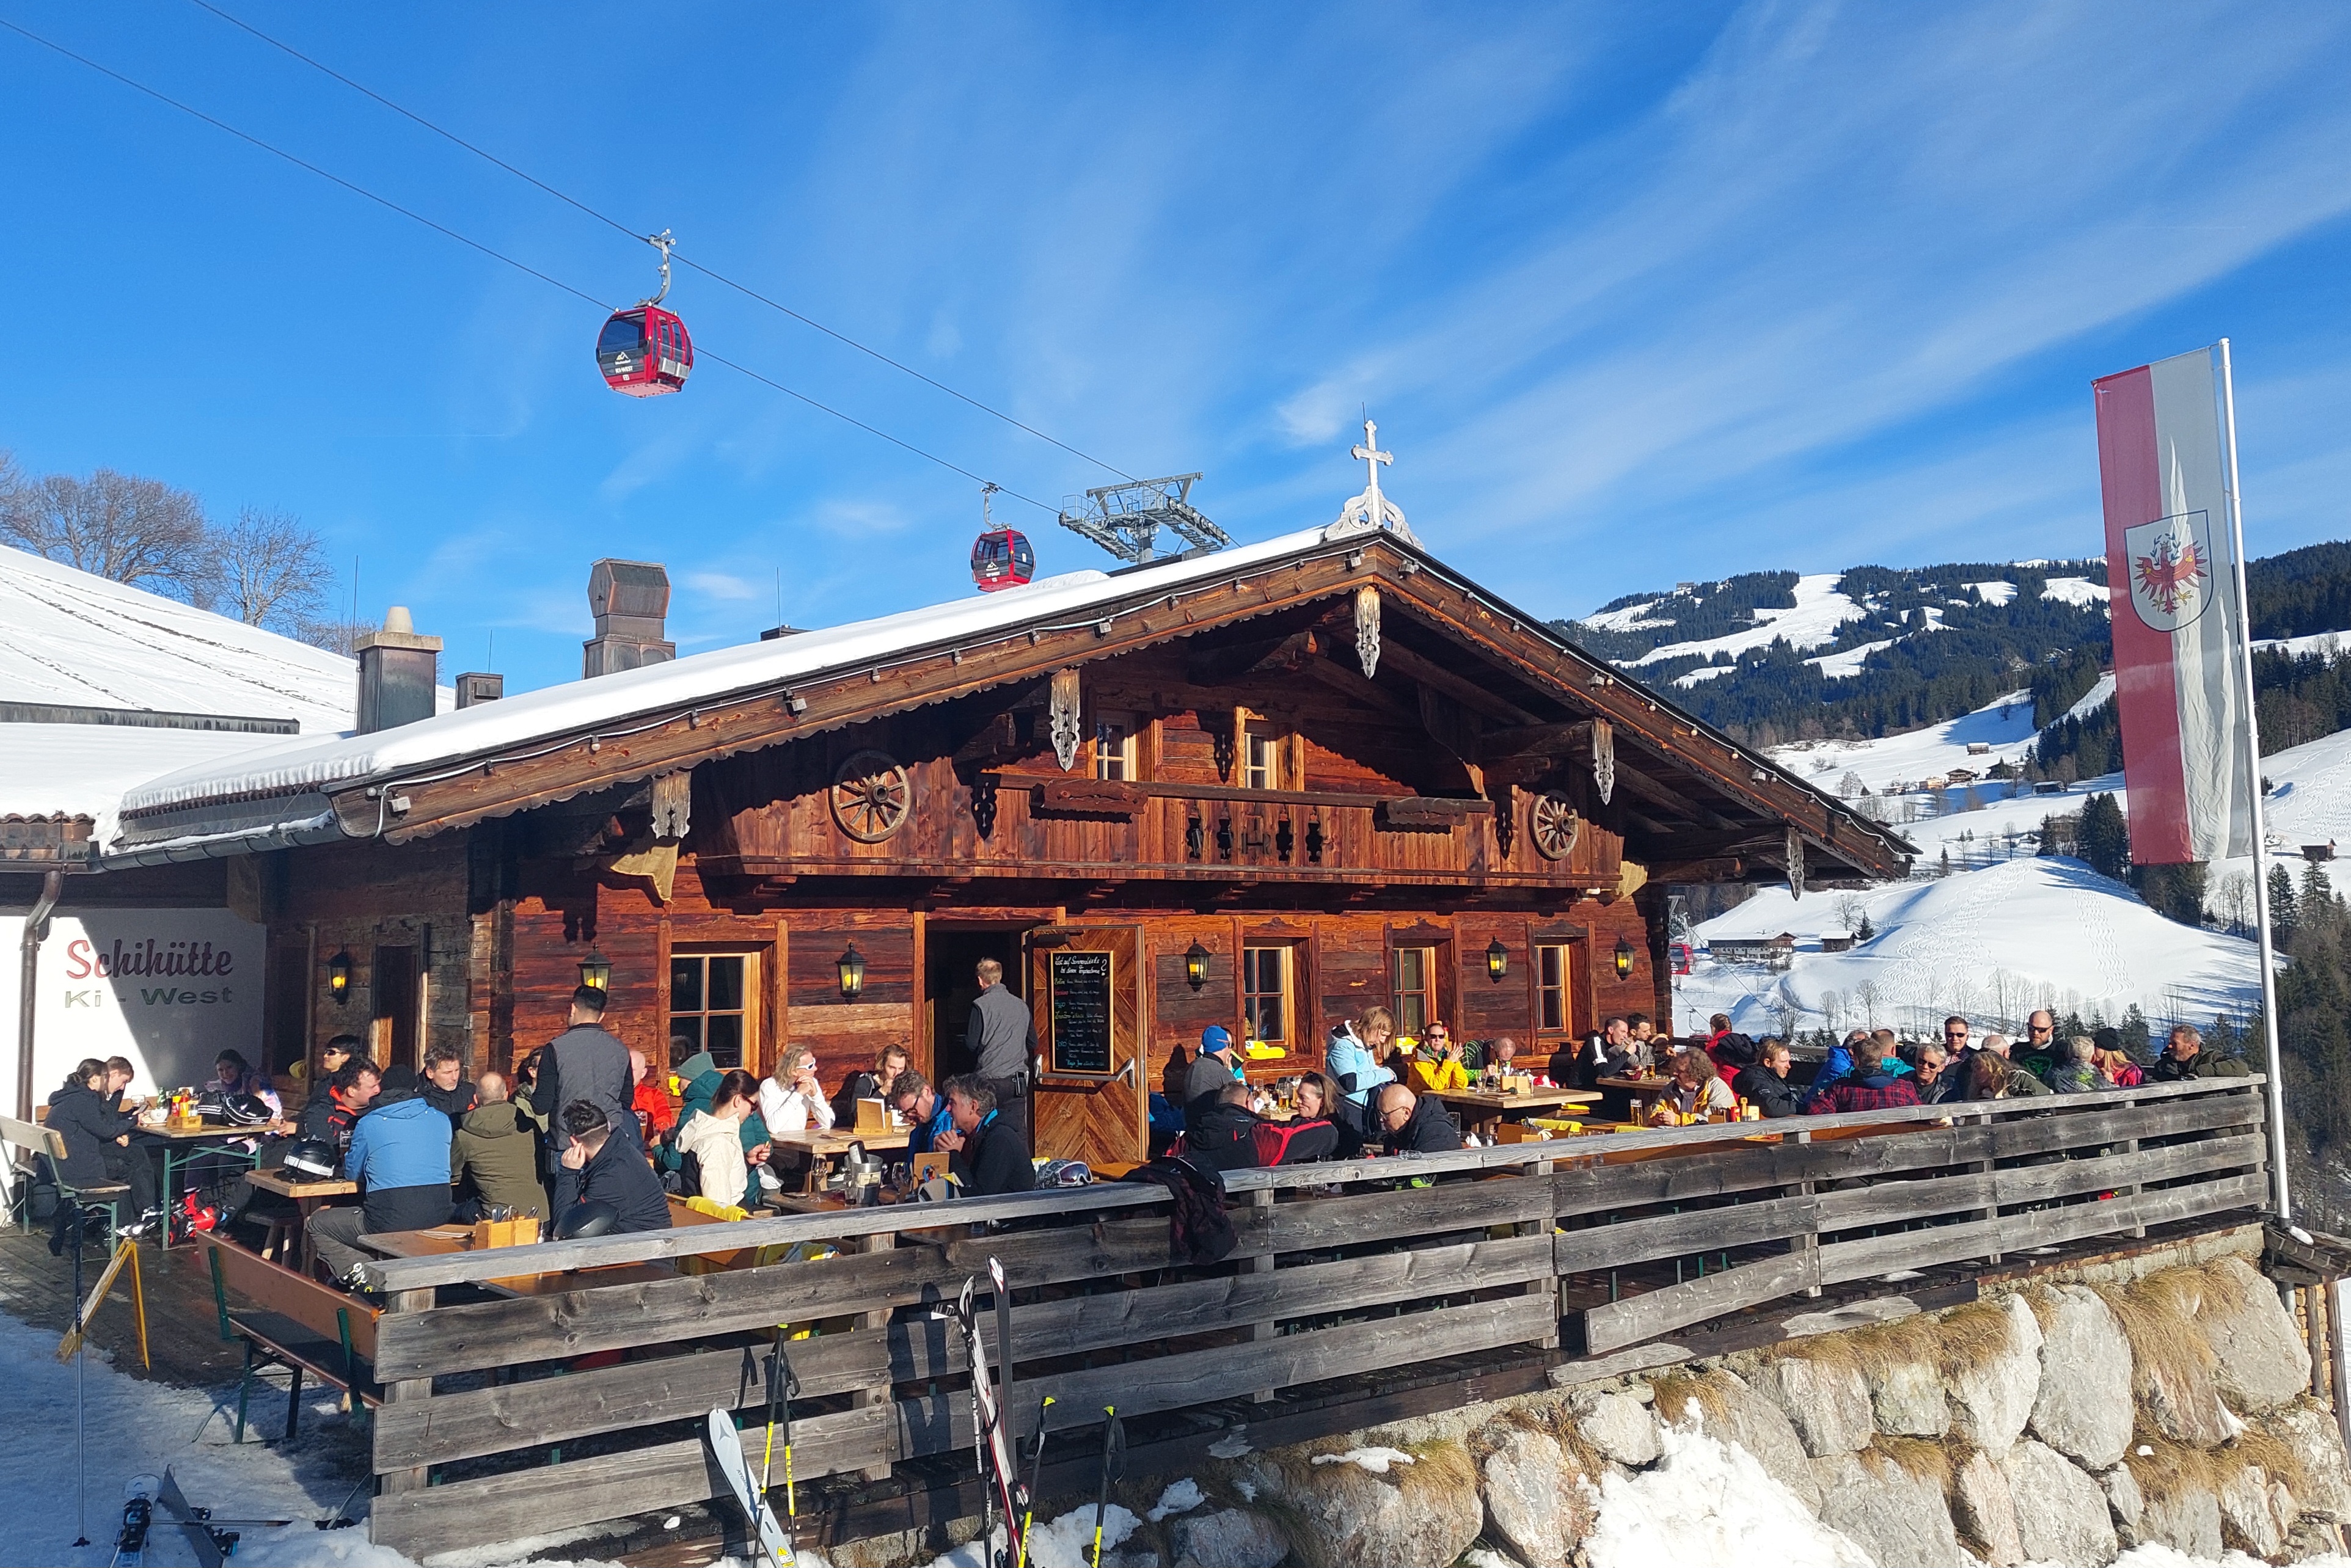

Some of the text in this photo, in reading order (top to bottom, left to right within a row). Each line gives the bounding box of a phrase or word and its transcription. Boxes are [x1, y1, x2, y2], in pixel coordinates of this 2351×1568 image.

[65, 938, 234, 980] Schihütte
[64, 989, 102, 1008] Ki
[141, 986, 233, 1006] West
